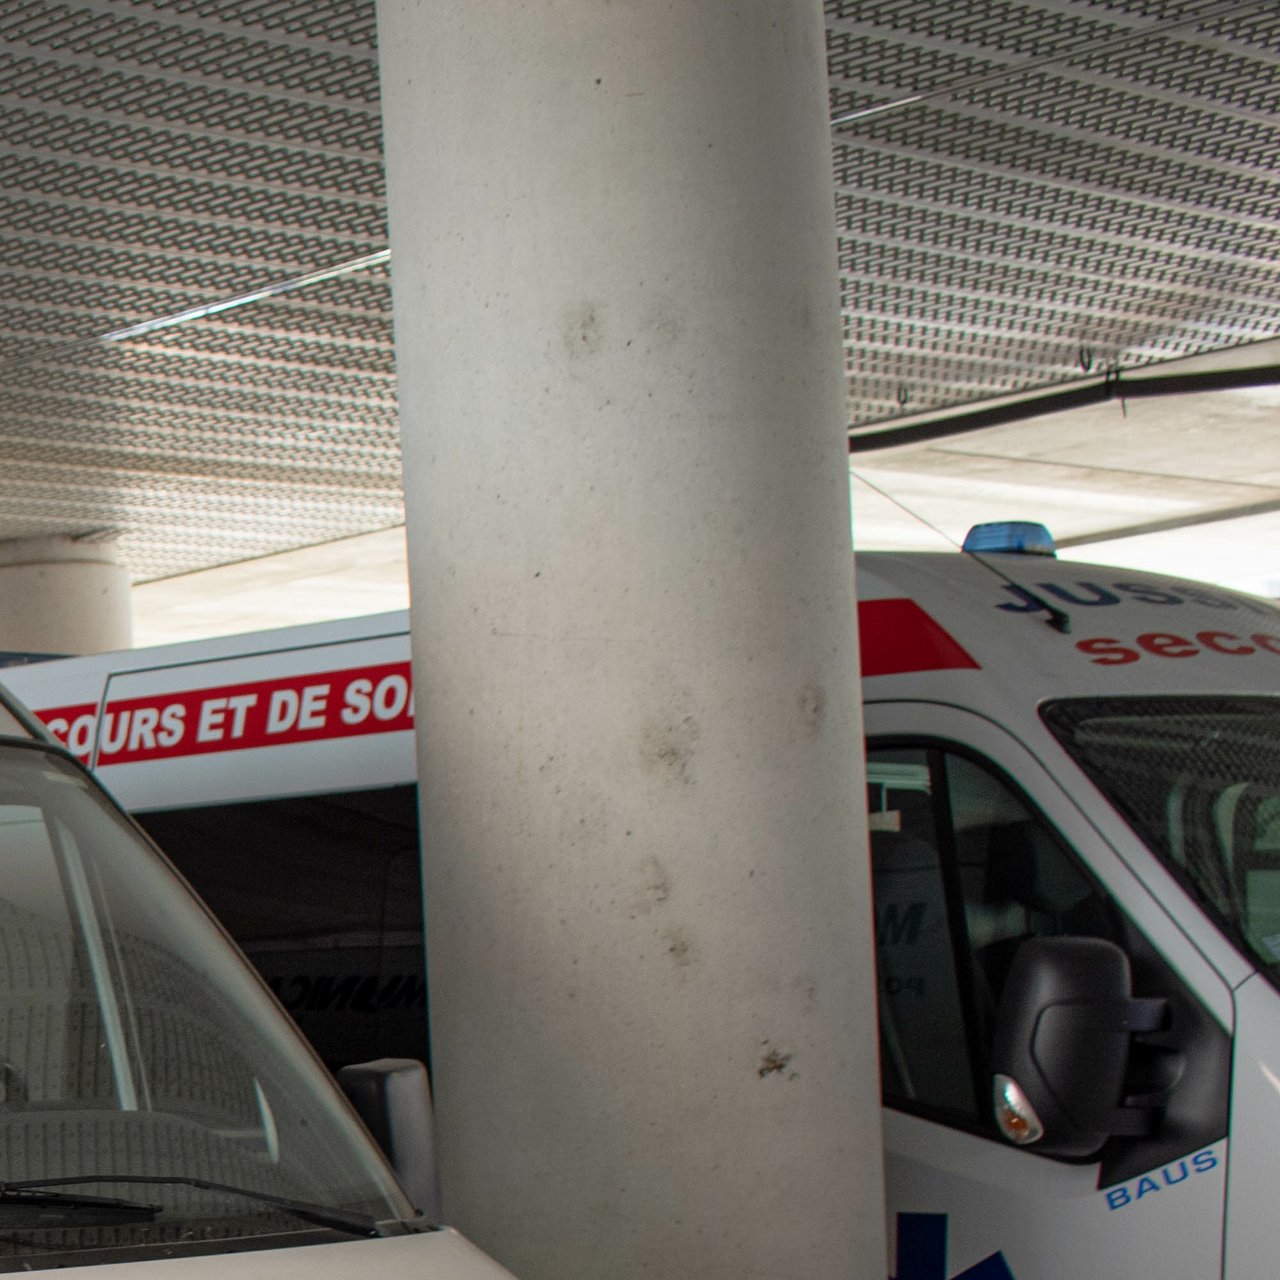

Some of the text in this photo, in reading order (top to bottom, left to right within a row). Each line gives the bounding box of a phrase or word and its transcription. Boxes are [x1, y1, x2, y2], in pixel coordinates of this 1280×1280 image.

[197, 694, 260, 743] ET
[266, 684, 331, 735] DE
[341, 674, 415, 725] SO
[1105, 1150, 1219, 1211] BAUS
